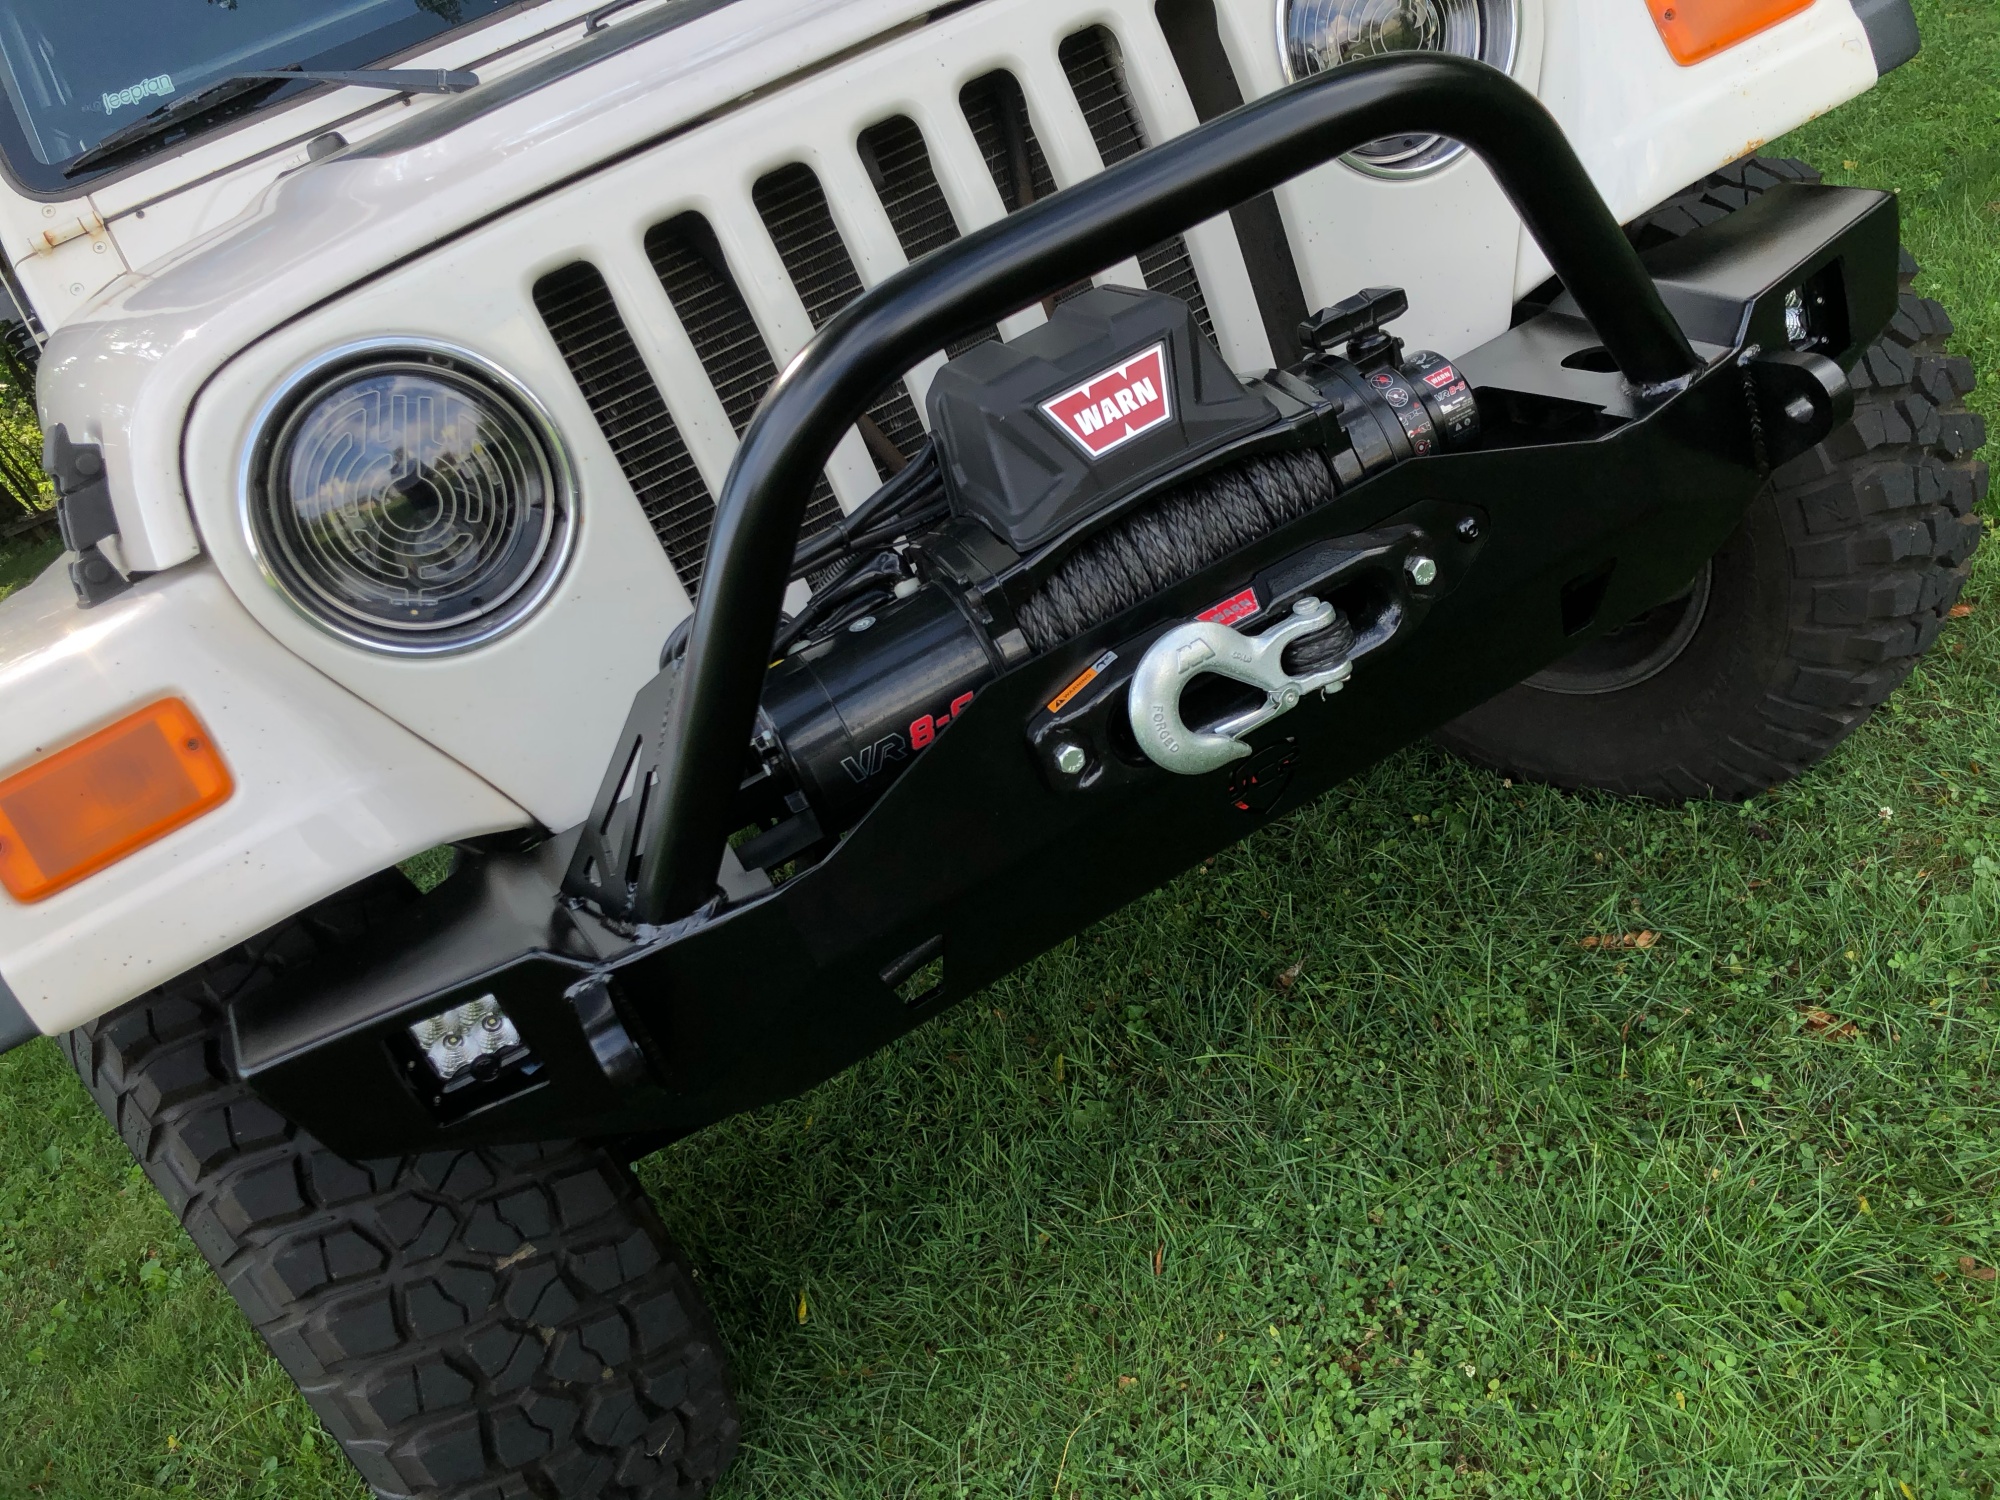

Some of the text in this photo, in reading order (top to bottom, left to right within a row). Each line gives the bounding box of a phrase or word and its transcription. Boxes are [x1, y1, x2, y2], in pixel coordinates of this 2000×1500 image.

[1430, 371, 1451, 384] WARN
[1073, 376, 1158, 436] WARN
[1212, 598, 1252, 623] WARN
[1063, 673, 1092, 698] WARNING
[1152, 704, 1180, 754] FORGED
